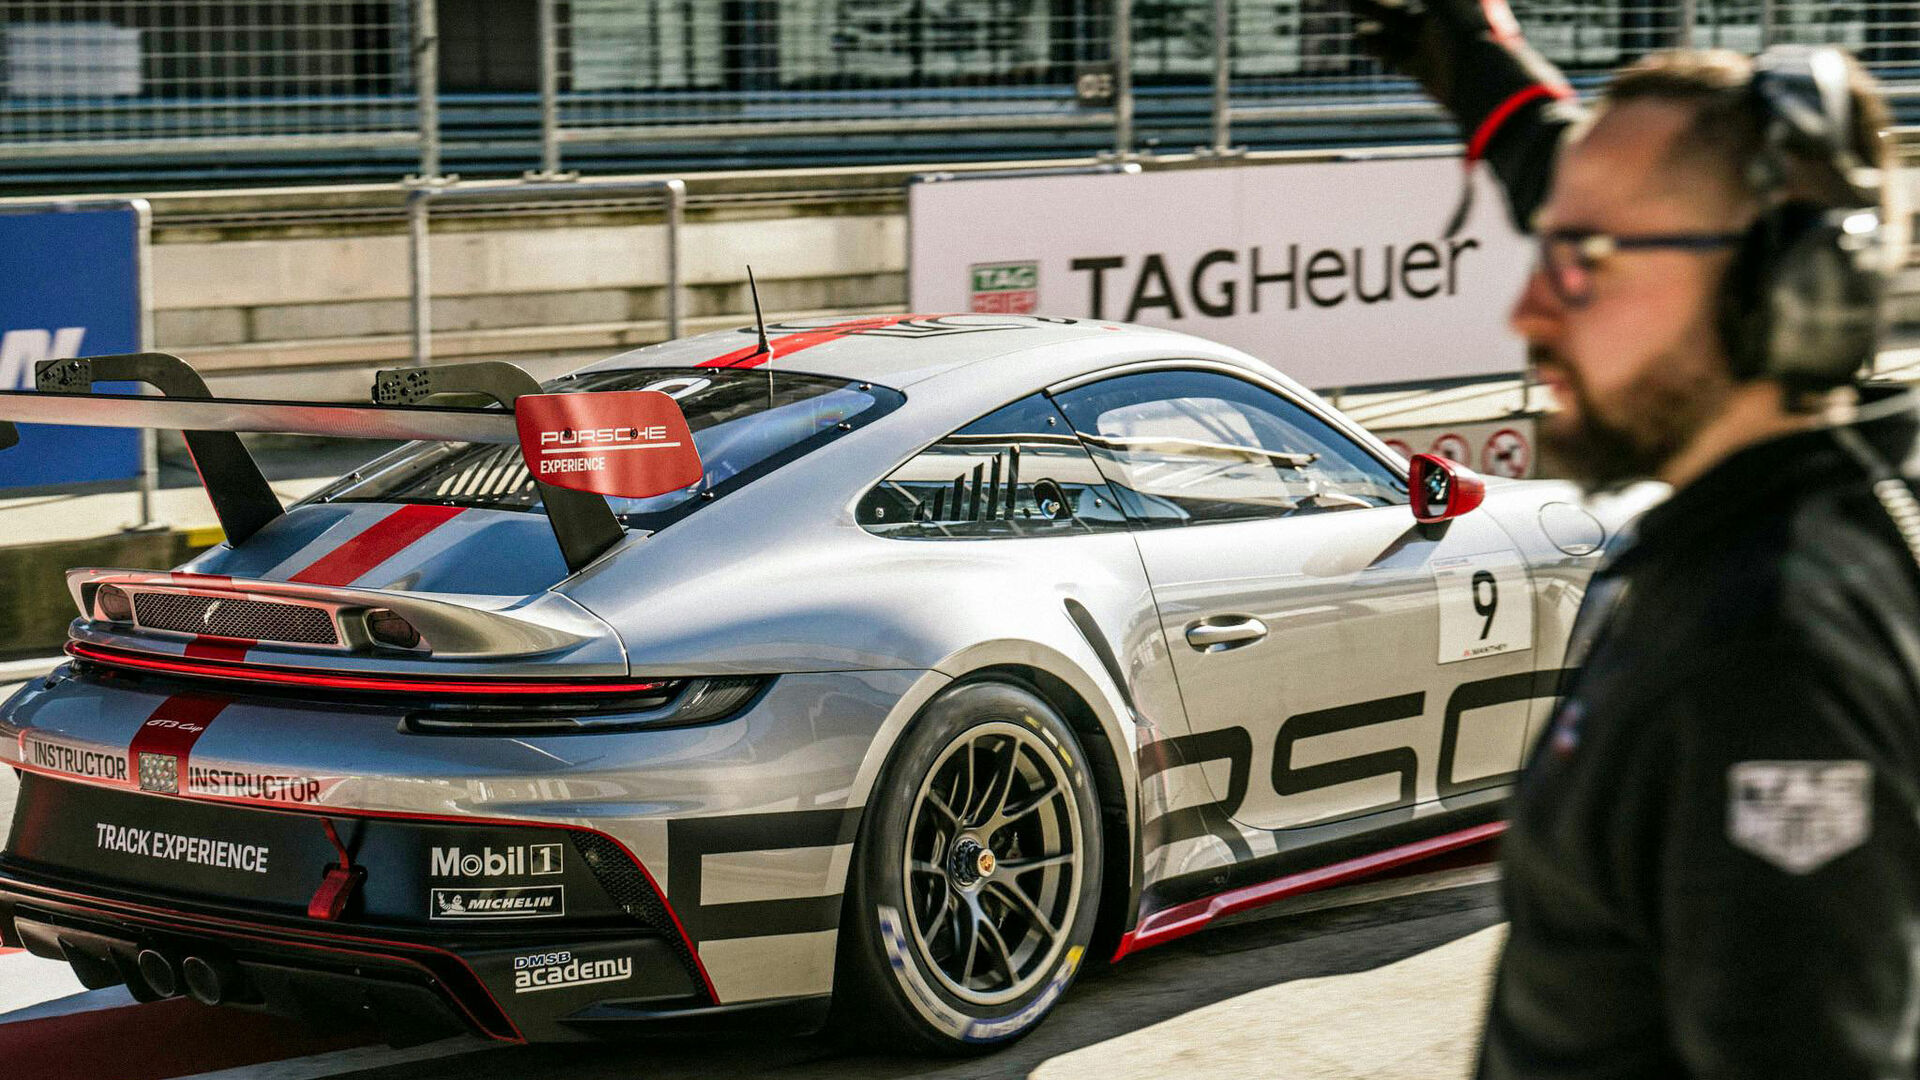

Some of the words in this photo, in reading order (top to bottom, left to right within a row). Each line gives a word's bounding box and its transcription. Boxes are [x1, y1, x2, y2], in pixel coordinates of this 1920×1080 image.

[541, 426, 667, 446] PORSCHE
[540, 456, 606, 474] EXPERIENCE
[1472, 570, 1498, 640] 9
[146, 719, 180, 728] GT3
[178, 723, 204, 733] Cup
[33, 740, 128, 781] INSTRUCTOR
[189, 766, 321, 804] INSTRUCTOR
[97, 822, 151, 852] TRACK
[152, 832, 269, 874] EXPERIENCE
[431, 847, 524, 876] Mobil
[540, 847, 551, 872] 1
[467, 896, 554, 911] MICHELIN
[514, 951, 572, 970] DMSB
[515, 956, 633, 988] academy
